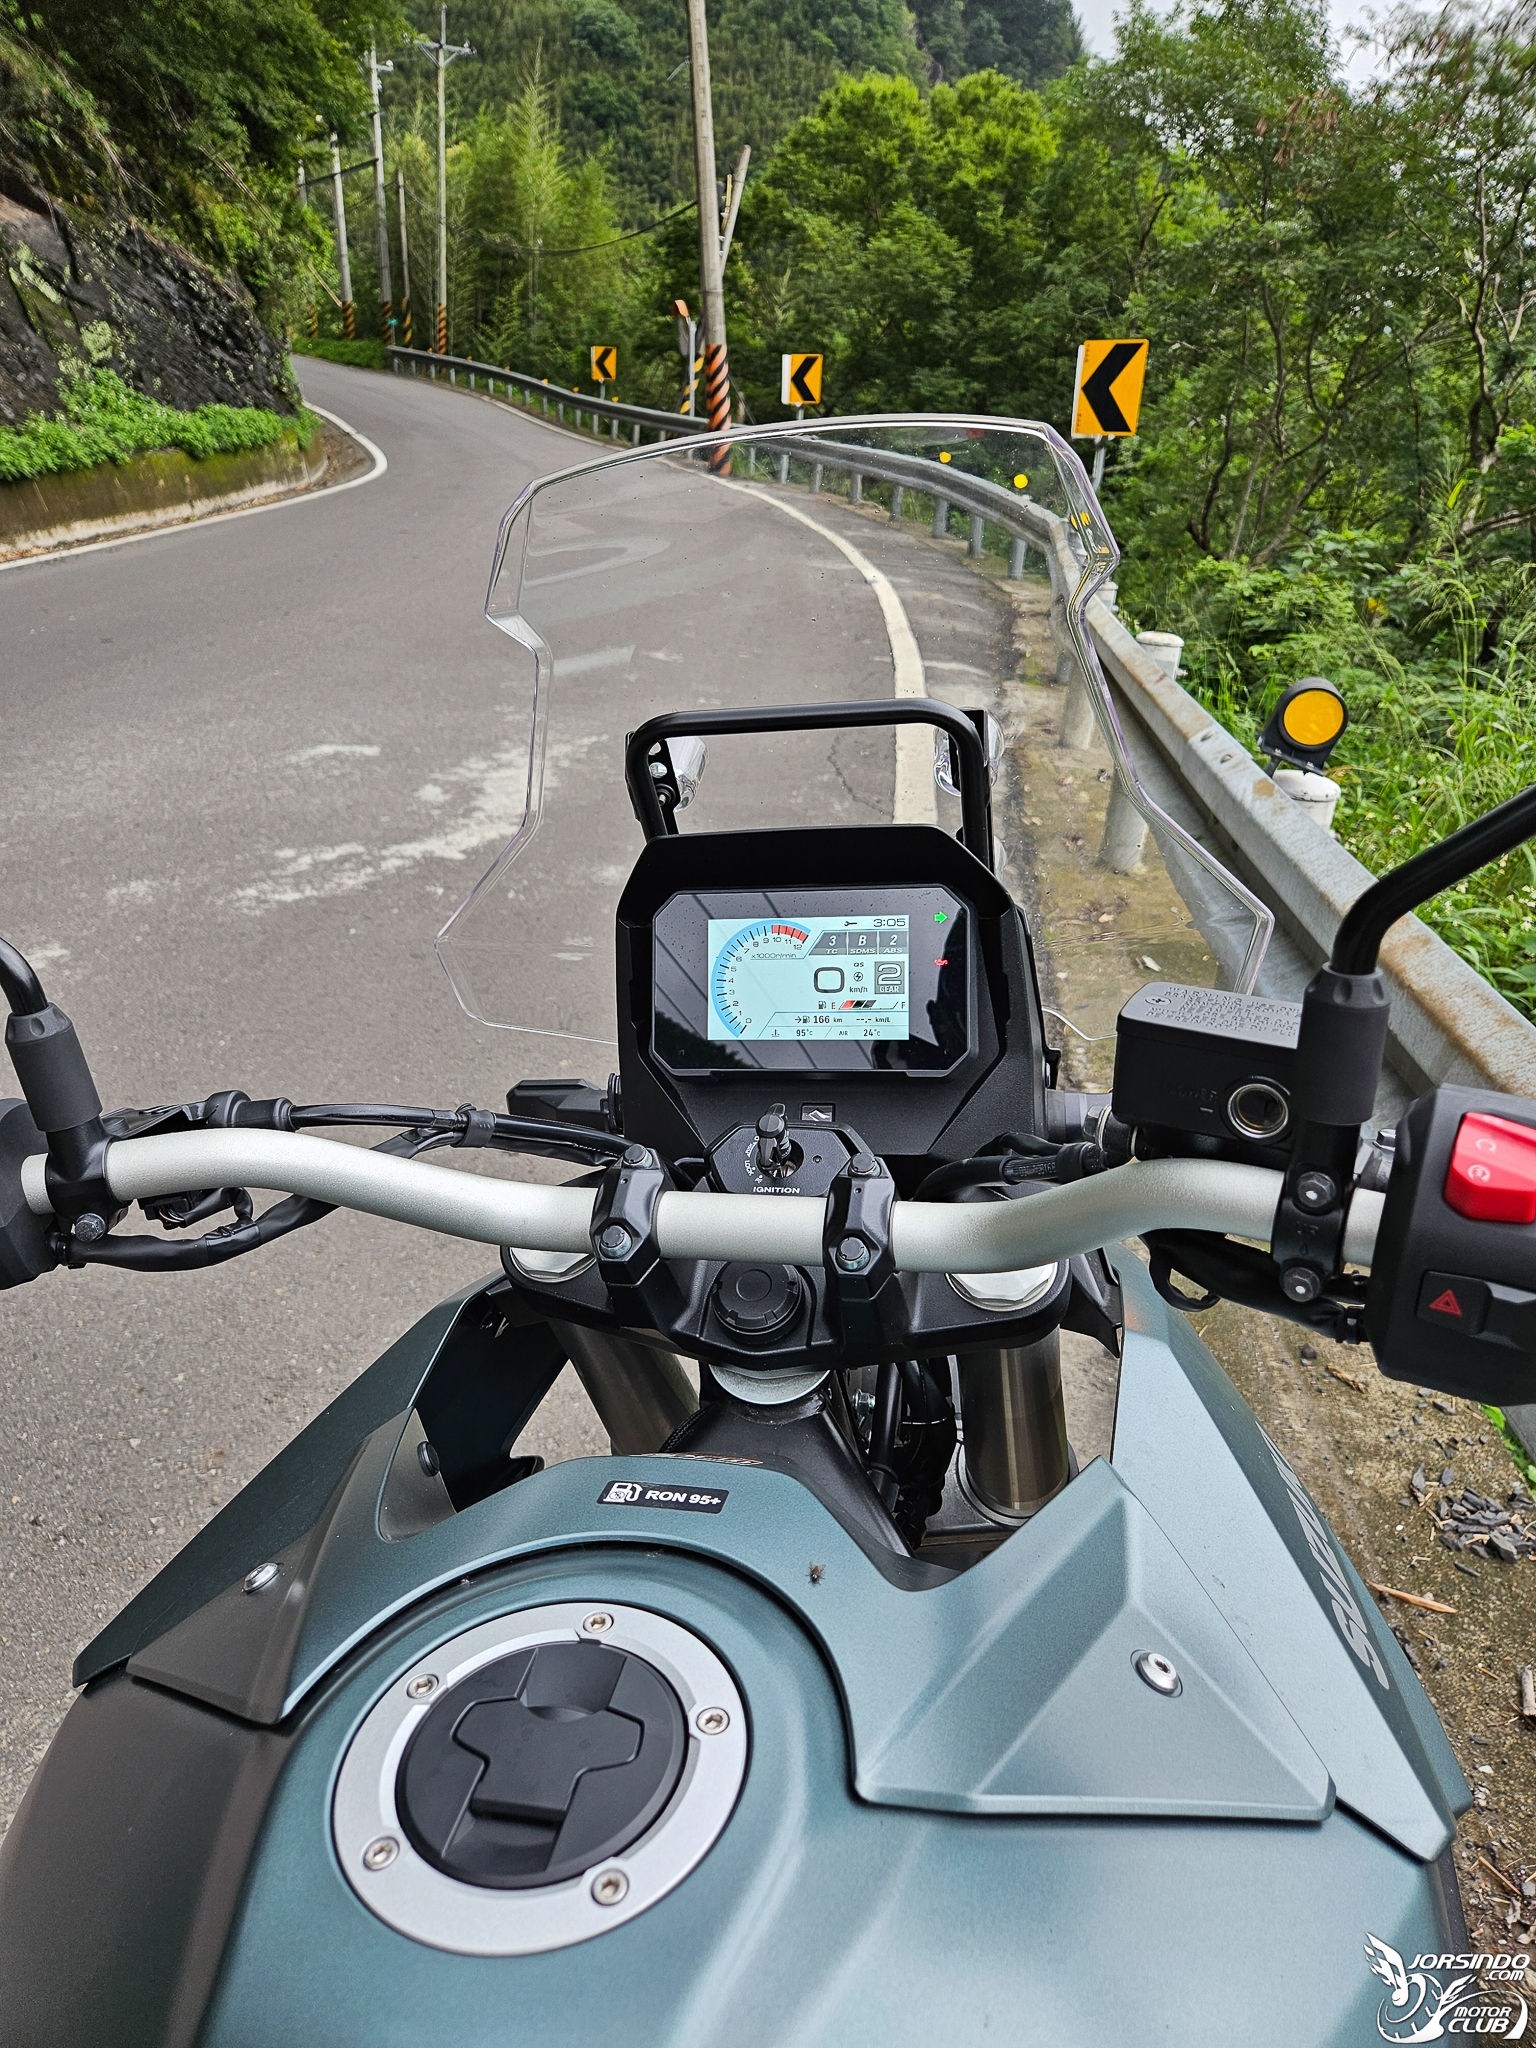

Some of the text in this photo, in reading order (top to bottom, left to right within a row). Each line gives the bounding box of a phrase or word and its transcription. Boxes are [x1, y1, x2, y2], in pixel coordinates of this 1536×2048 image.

[873, 918, 906, 928] 3:05
[828, 935, 837, 946] 3
[858, 934, 867, 946] B
[889, 934, 898, 946] 2
[877, 962, 902, 985] 2
[814, 967, 845, 993] 0
[831, 1002, 836, 1010] E
[813, 1015, 831, 1024] 166
[753, 1186, 800, 1194] IGNITION
[644, 1490, 722, 1505] RON 95+
